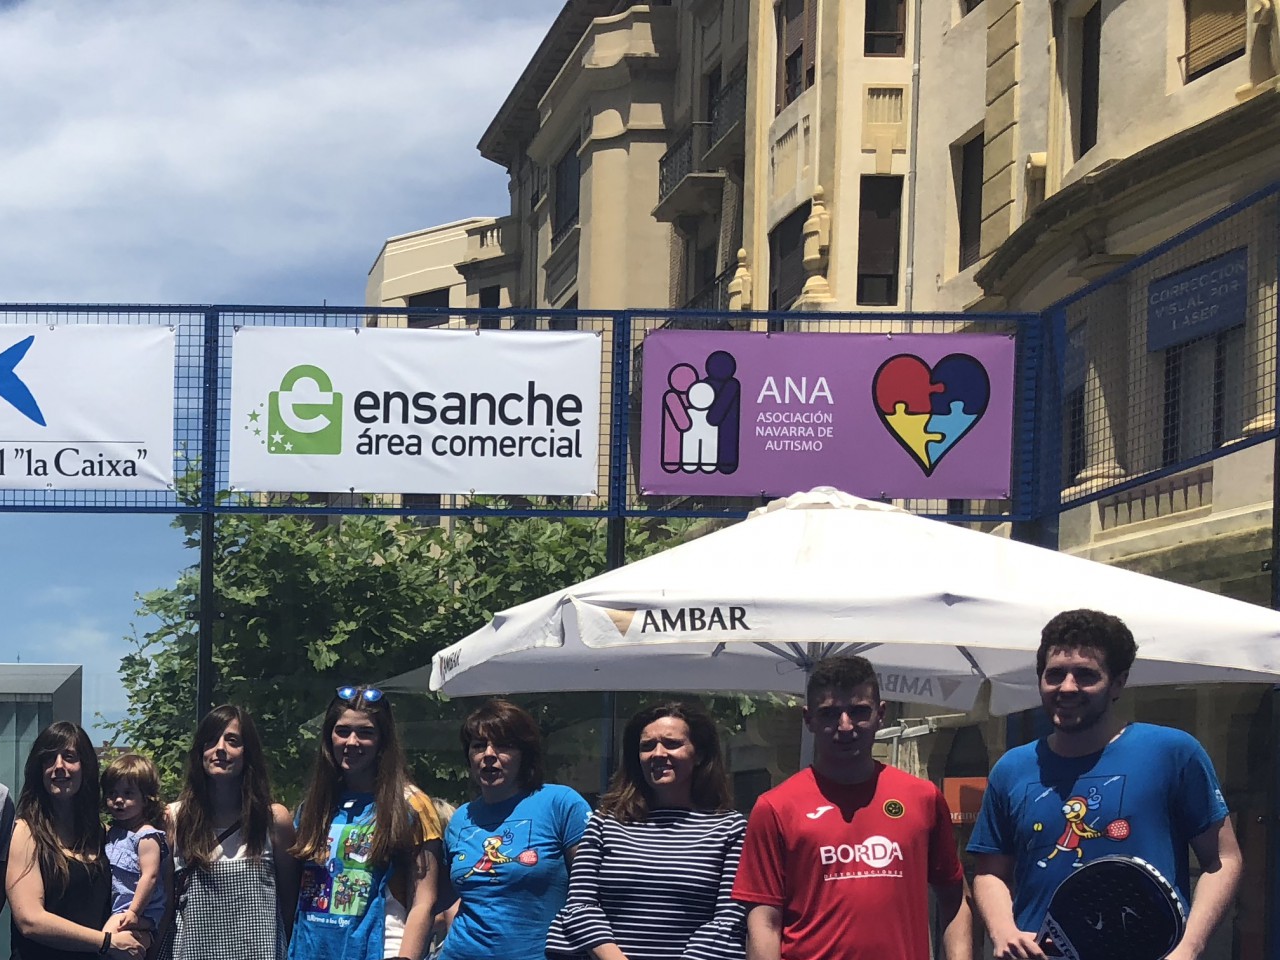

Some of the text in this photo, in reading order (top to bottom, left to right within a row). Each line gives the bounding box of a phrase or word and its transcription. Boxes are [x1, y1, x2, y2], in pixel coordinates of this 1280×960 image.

[353, 380, 583, 427] ensanche
[756, 376, 835, 405] ANA
[756, 410, 833, 424] ASOCIACIÓN
[355, 427, 583, 459] área comercial
[755, 426, 834, 438] NAVARRA DE
[764, 440, 823, 452] AUTISMO
[640, 606, 751, 634] AMBAR
[819, 841, 904, 866] BORDA
